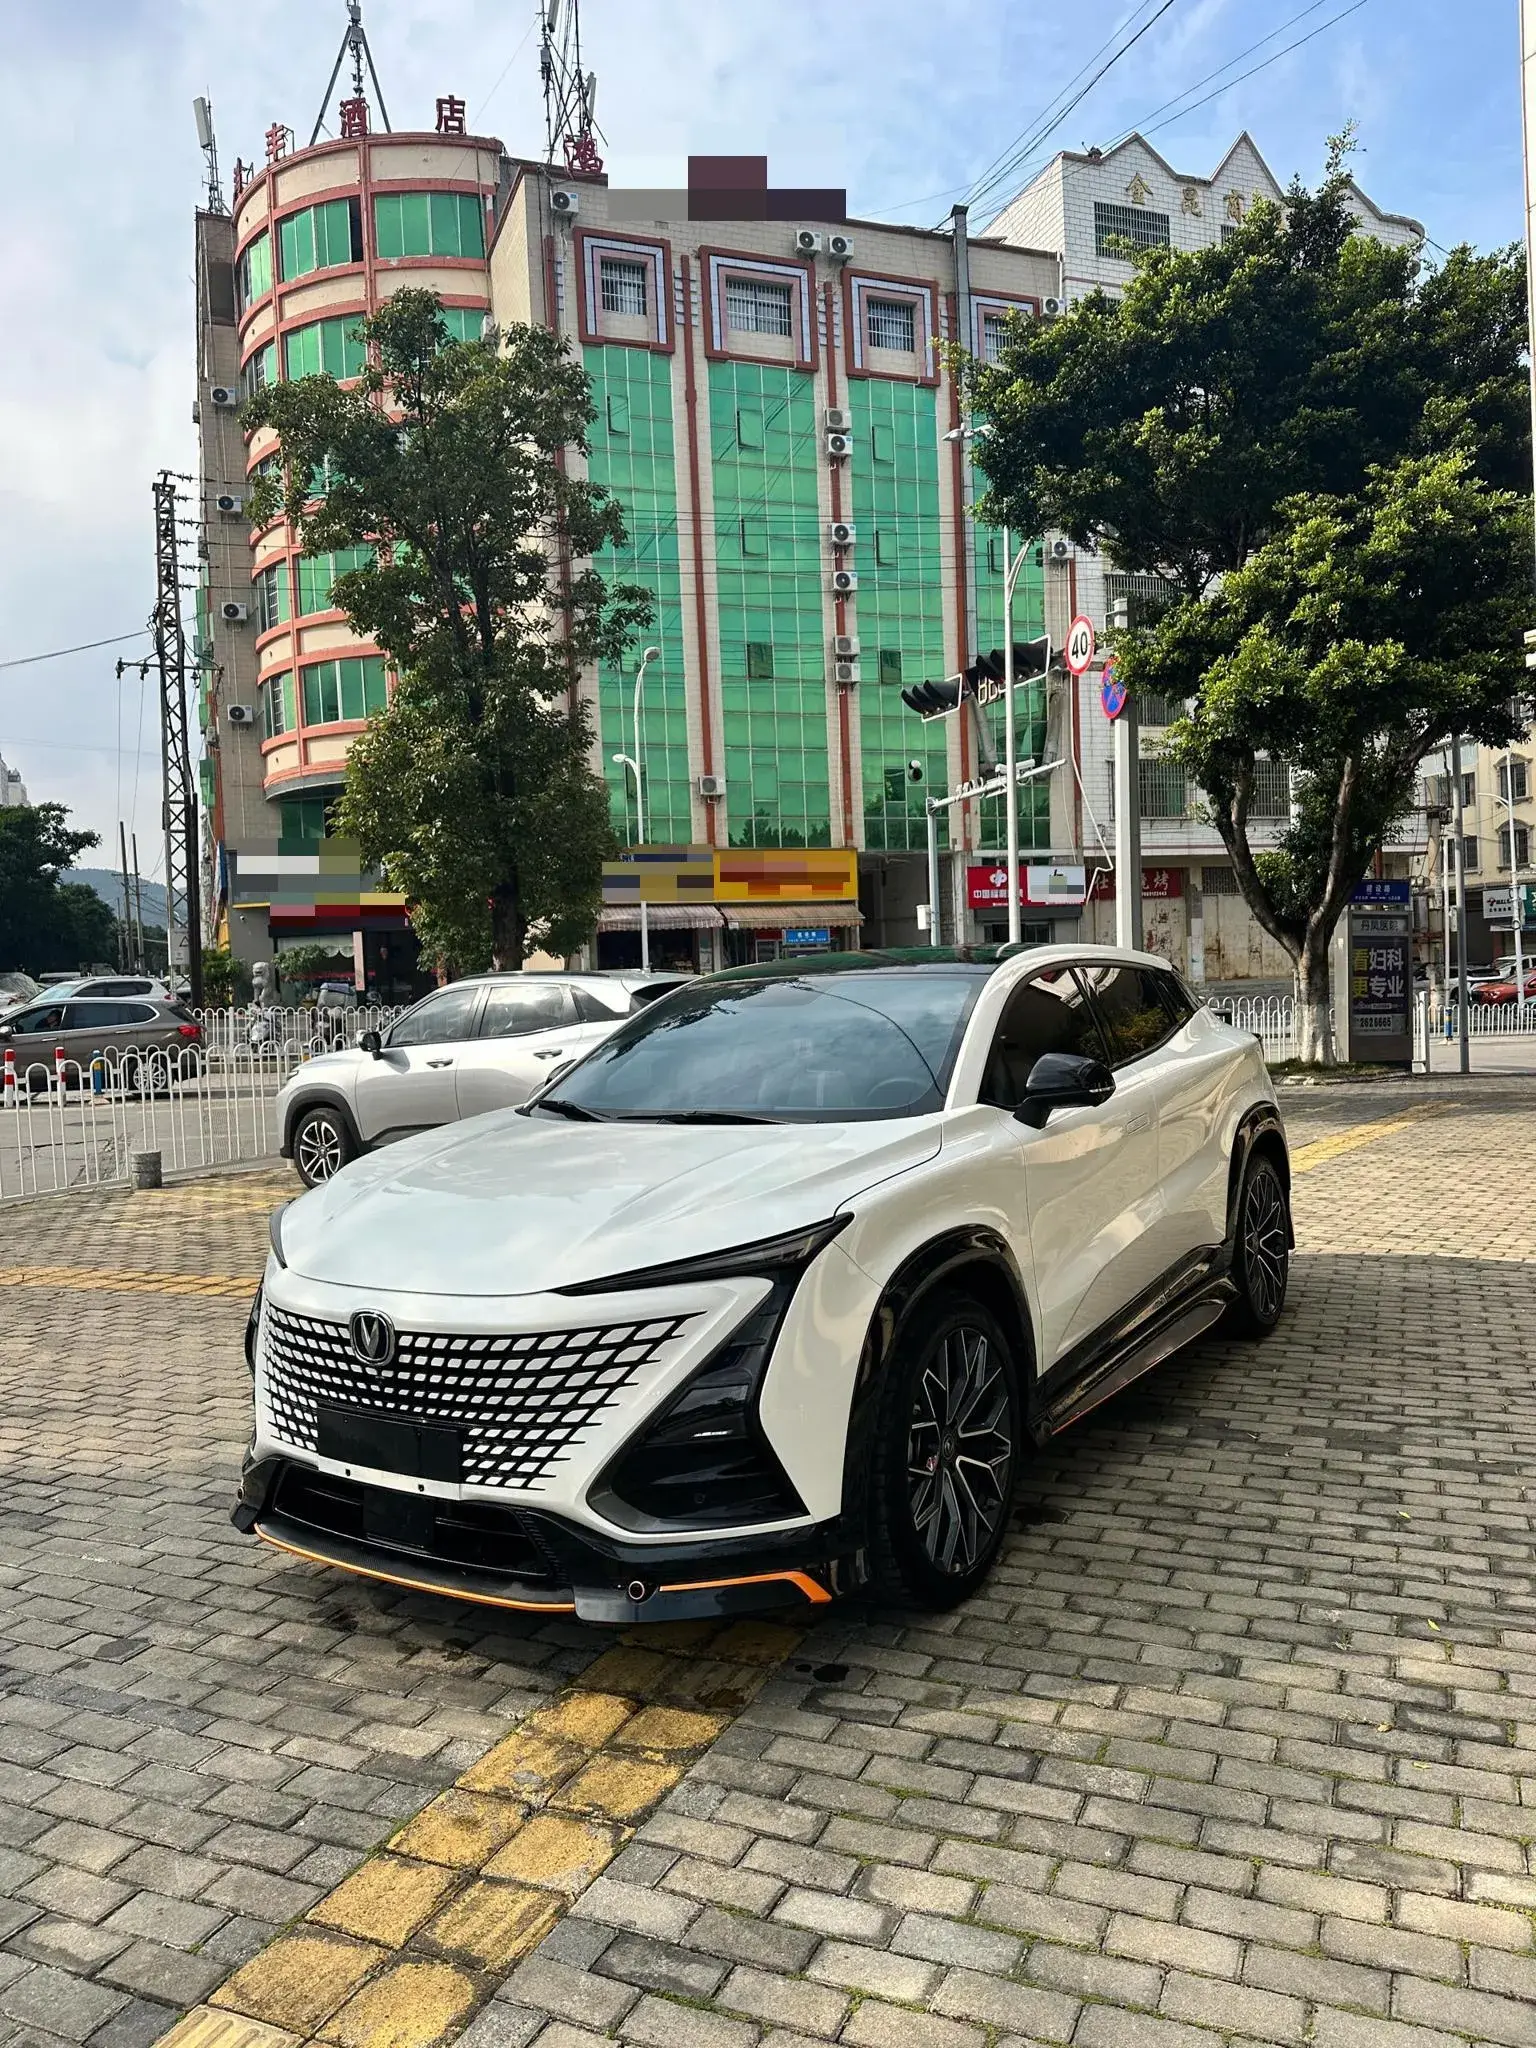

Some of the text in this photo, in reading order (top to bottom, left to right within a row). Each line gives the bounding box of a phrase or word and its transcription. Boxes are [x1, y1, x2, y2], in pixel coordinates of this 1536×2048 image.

[1071, 631, 1088, 659] 40
[1353, 948, 1404, 971] 看妇科
[1353, 975, 1405, 998] 更专业
